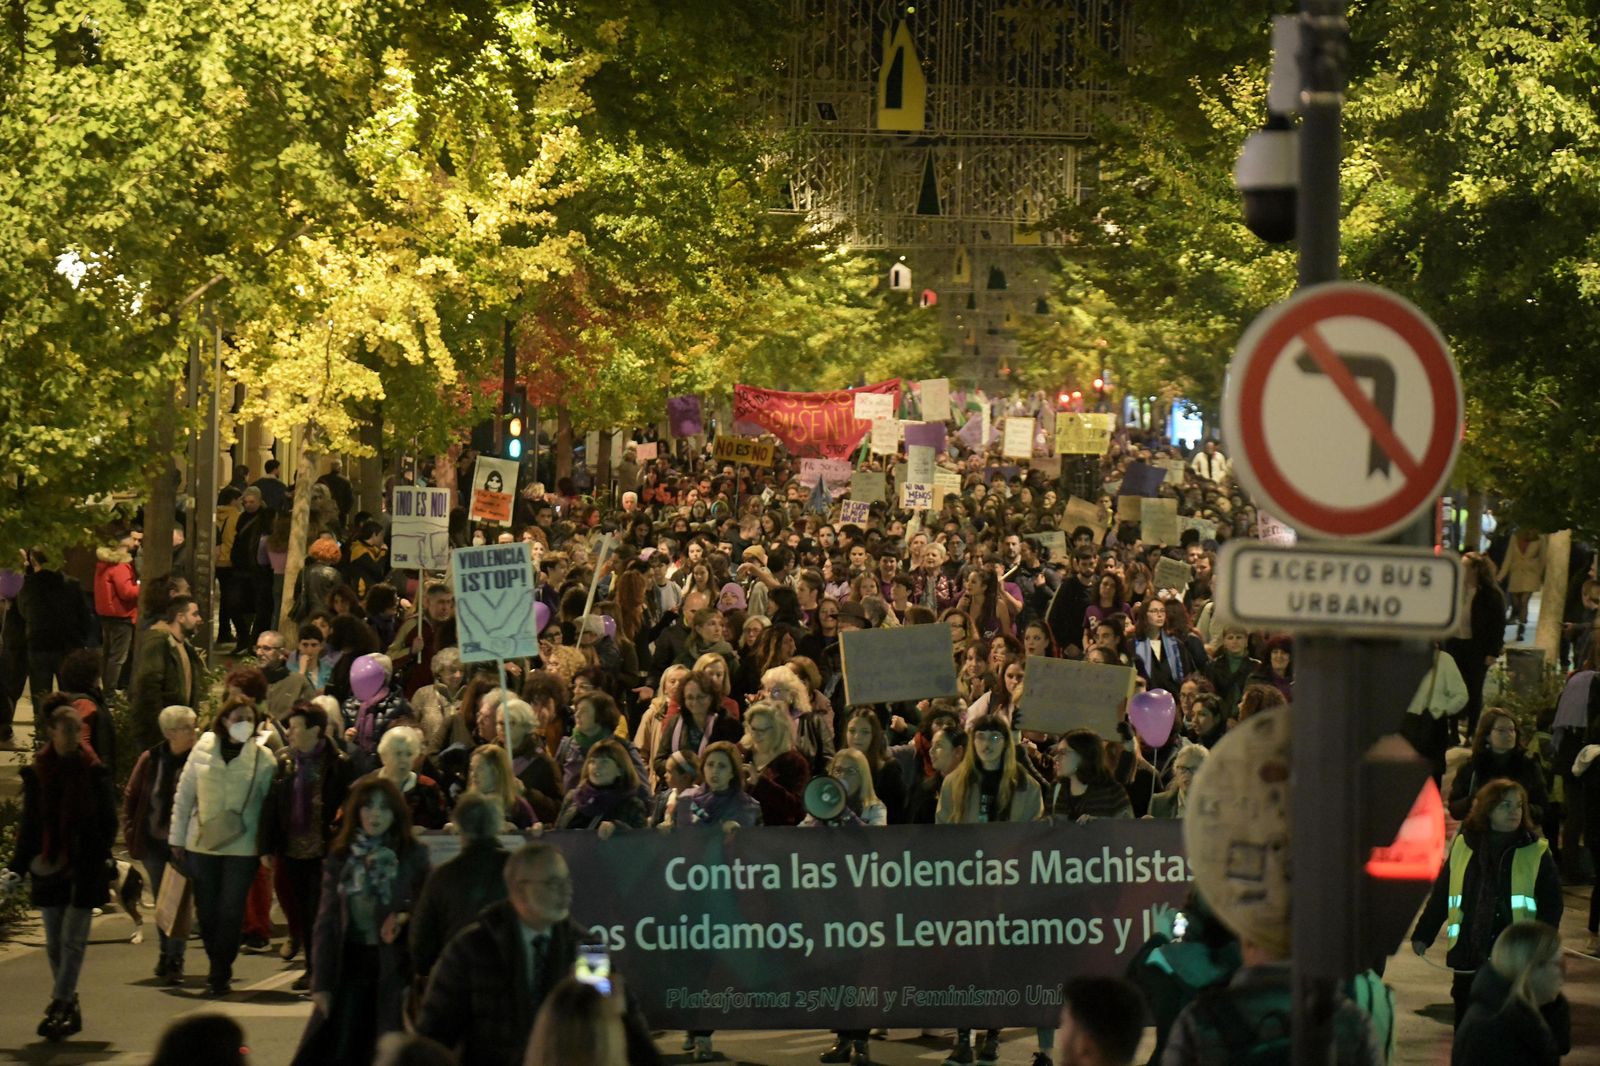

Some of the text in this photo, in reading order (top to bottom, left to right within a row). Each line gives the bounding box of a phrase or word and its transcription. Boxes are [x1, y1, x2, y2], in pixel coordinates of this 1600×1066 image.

[784, 391, 851, 409] SEXO
[716, 438, 768, 461] NO ES NO
[416, 492, 427, 517] ES
[431, 492, 447, 518] NO!
[908, 491, 932, 500] MENOS
[458, 547, 526, 569] VIOLENCIA
[461, 568, 527, 593] ¡STOP!
[1250, 558, 1433, 587] EXCEPTO BUS
[1287, 592, 1402, 617] URBANO
[665, 856, 781, 891] Contra
[790, 853, 838, 889] las
[845, 849, 1019, 888] Violencias
[588, 924, 626, 951] os
[635, 913, 814, 957] Cuidamos,
[824, 920, 886, 948] nos
[896, 913, 1104, 947] Levantamos
[1113, 917, 1132, 954] y
[666, 983, 1064, 1013] Plataforma 25N/8M y Feminismo Uni
